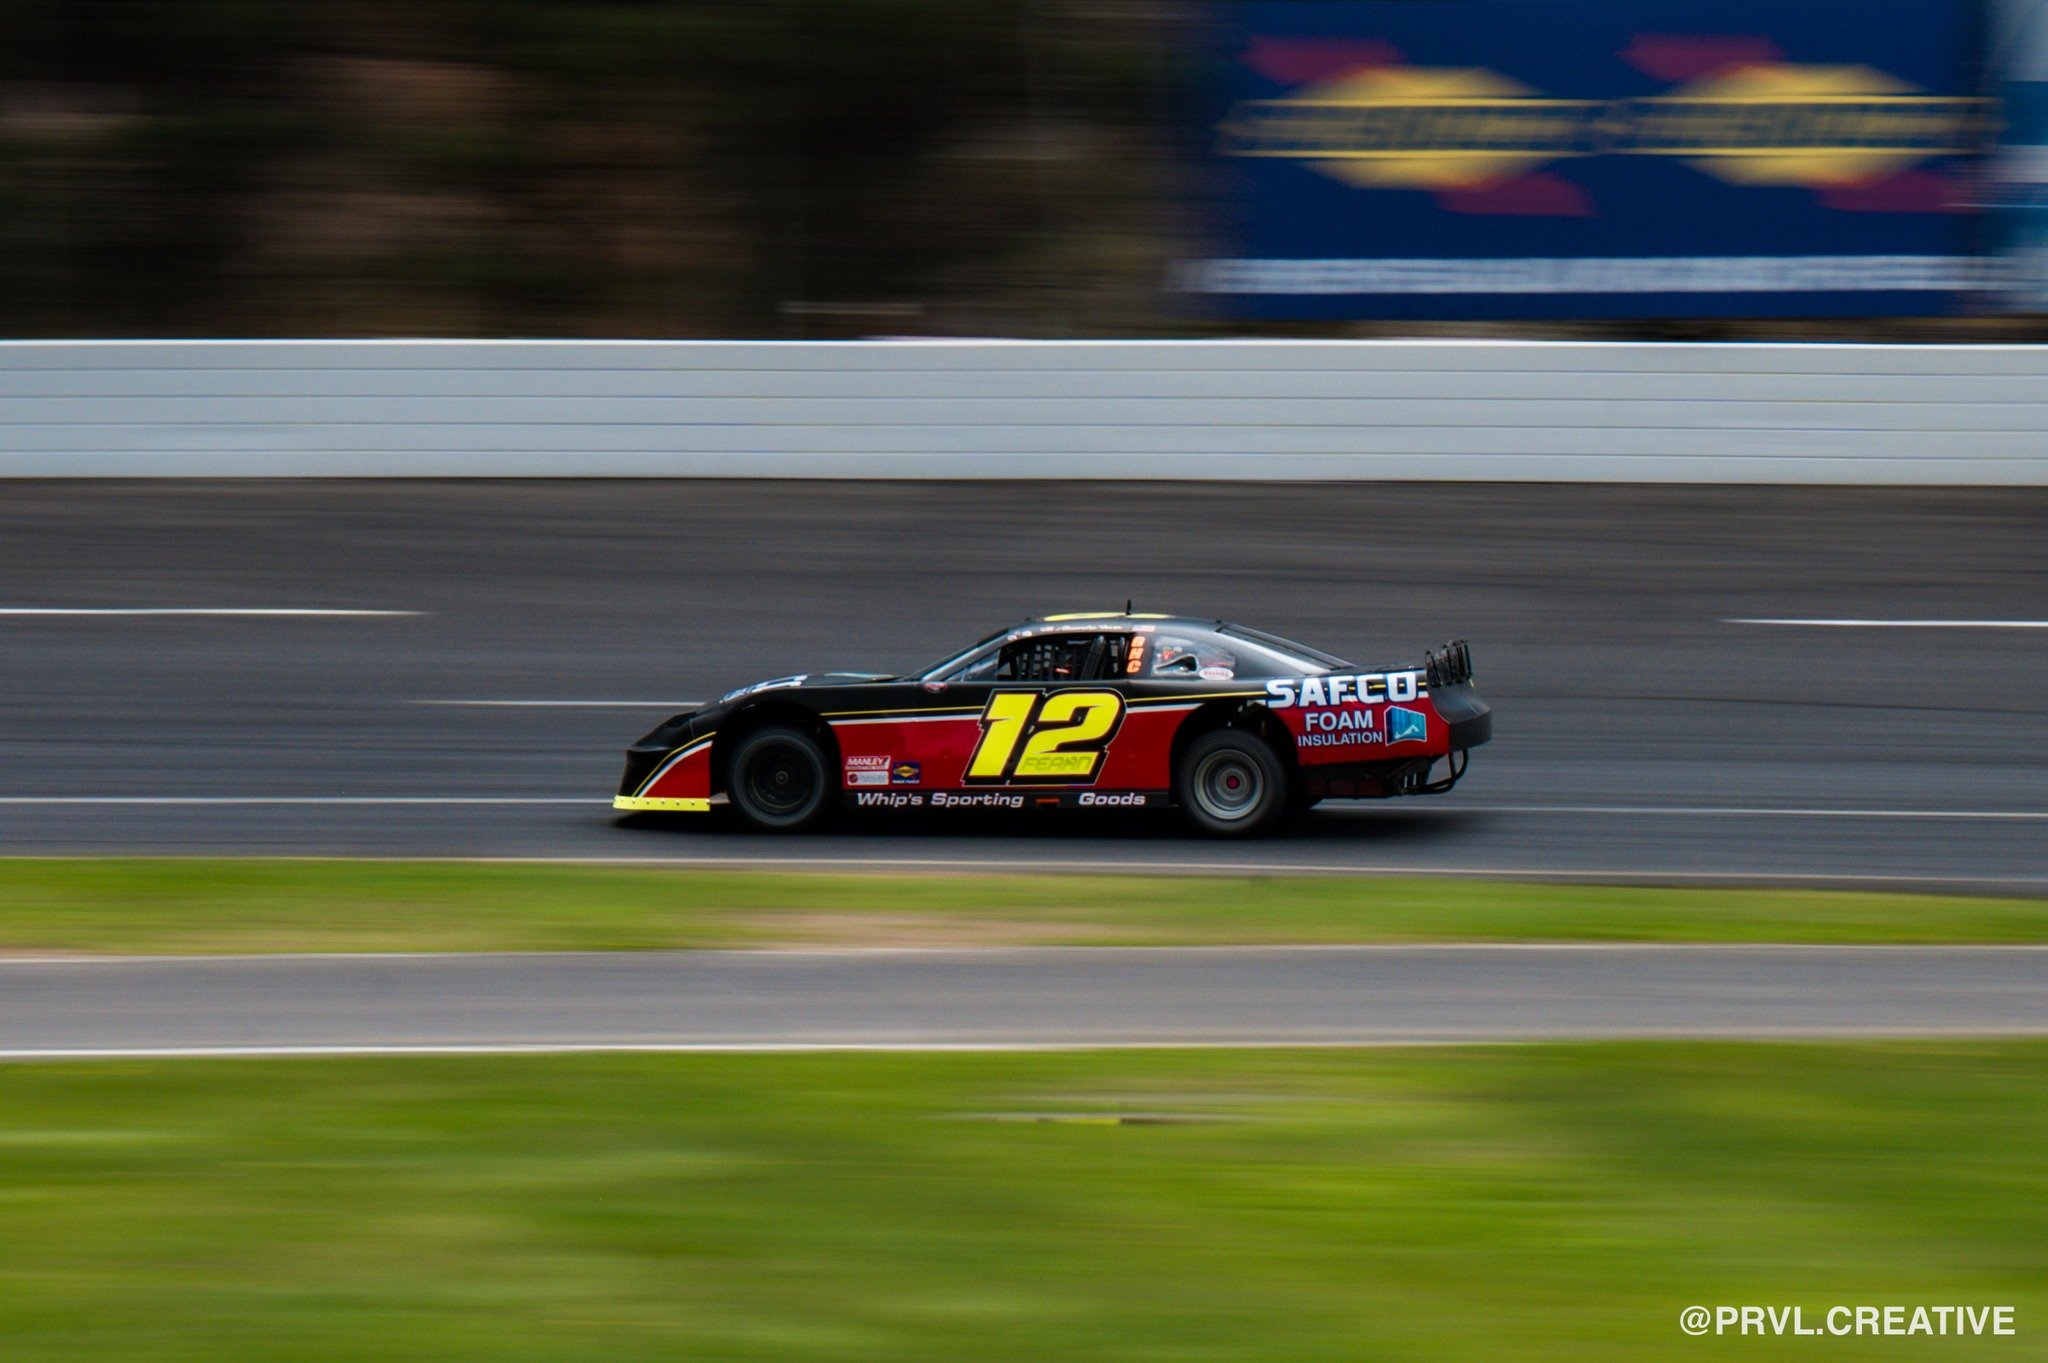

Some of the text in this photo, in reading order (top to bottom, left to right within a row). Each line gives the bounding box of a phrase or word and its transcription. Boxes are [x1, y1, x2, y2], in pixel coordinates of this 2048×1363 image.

[1266, 671, 1417, 709] SAFCO
[1305, 708, 1374, 732] FOAM
[966, 691, 1122, 778] 12
[1298, 731, 1384, 747] INSULATION
[857, 792, 1147, 808] Whip's Sporting Goods
